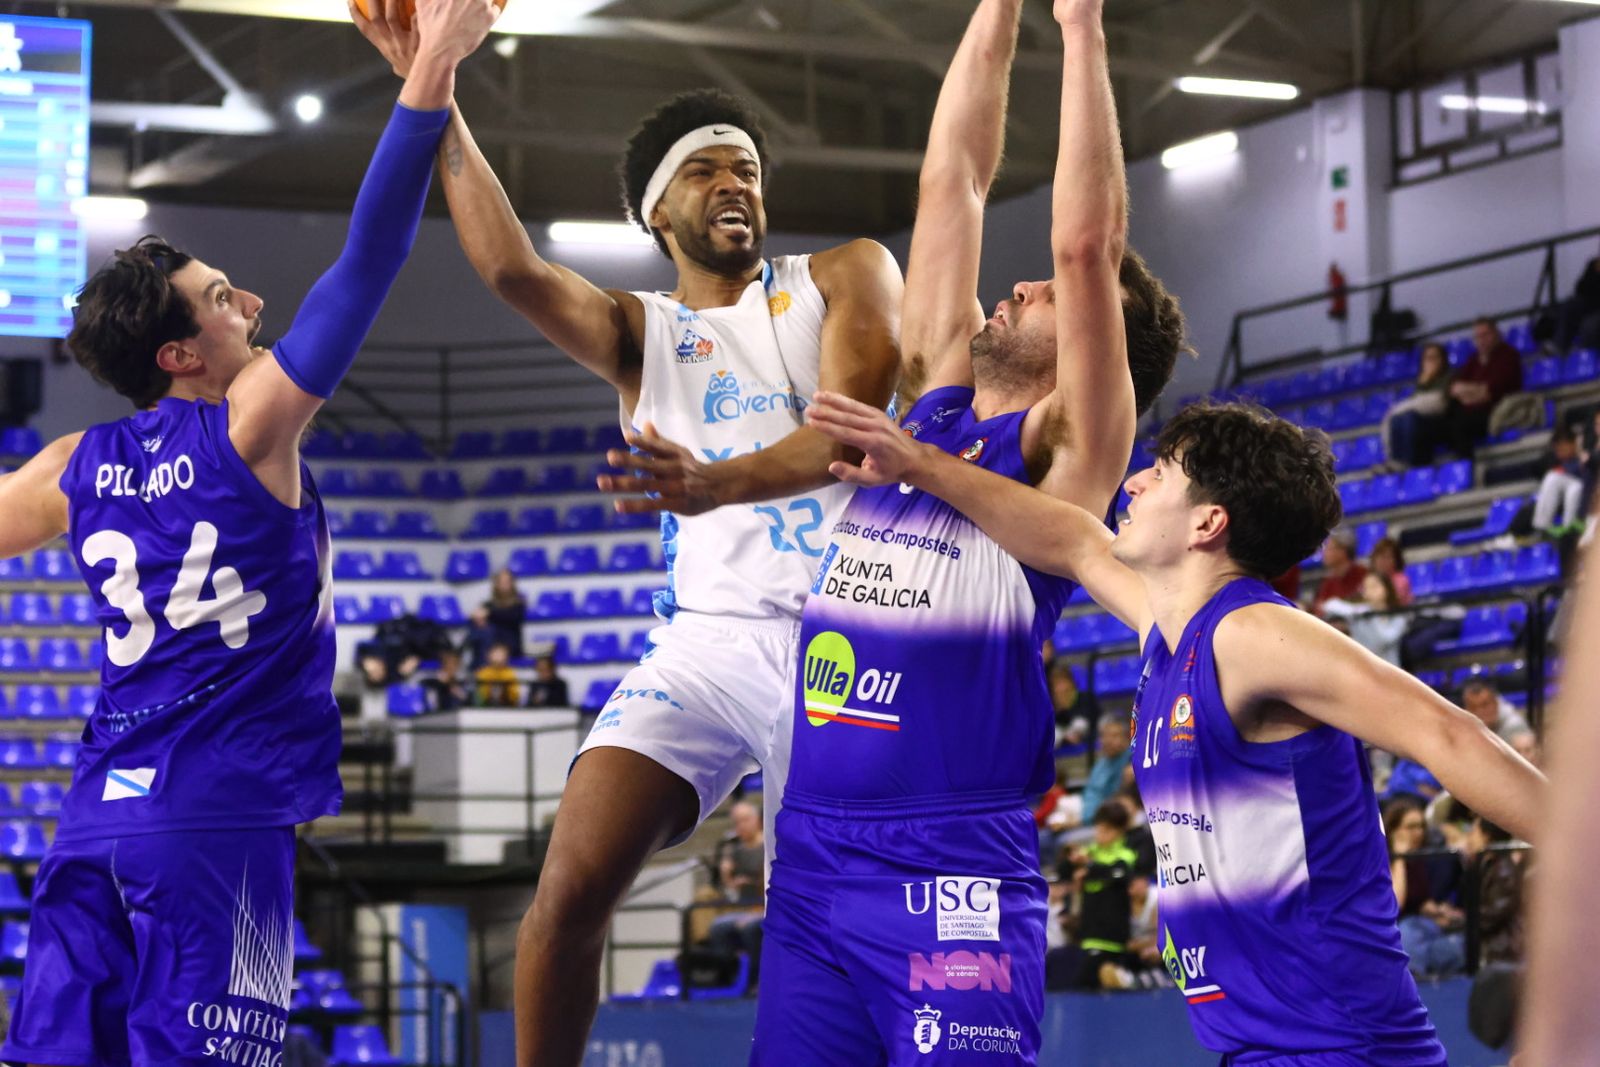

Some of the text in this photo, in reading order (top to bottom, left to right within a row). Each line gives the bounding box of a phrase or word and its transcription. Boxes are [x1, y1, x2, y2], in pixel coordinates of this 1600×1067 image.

[715, 390, 808, 421] aveni
[834, 553, 893, 582] XUNTA
[82, 521, 267, 667] 34
[825, 577, 931, 609] DE GALICIA
[806, 655, 902, 704] Ulla Oil
[901, 879, 992, 914] USC
[950, 929, 994, 938] COMPOSTELA
[908, 949, 1012, 993] NON
[948, 1037, 1021, 1056] DA CORUÑA
[949, 1021, 1021, 1042] Deputación
